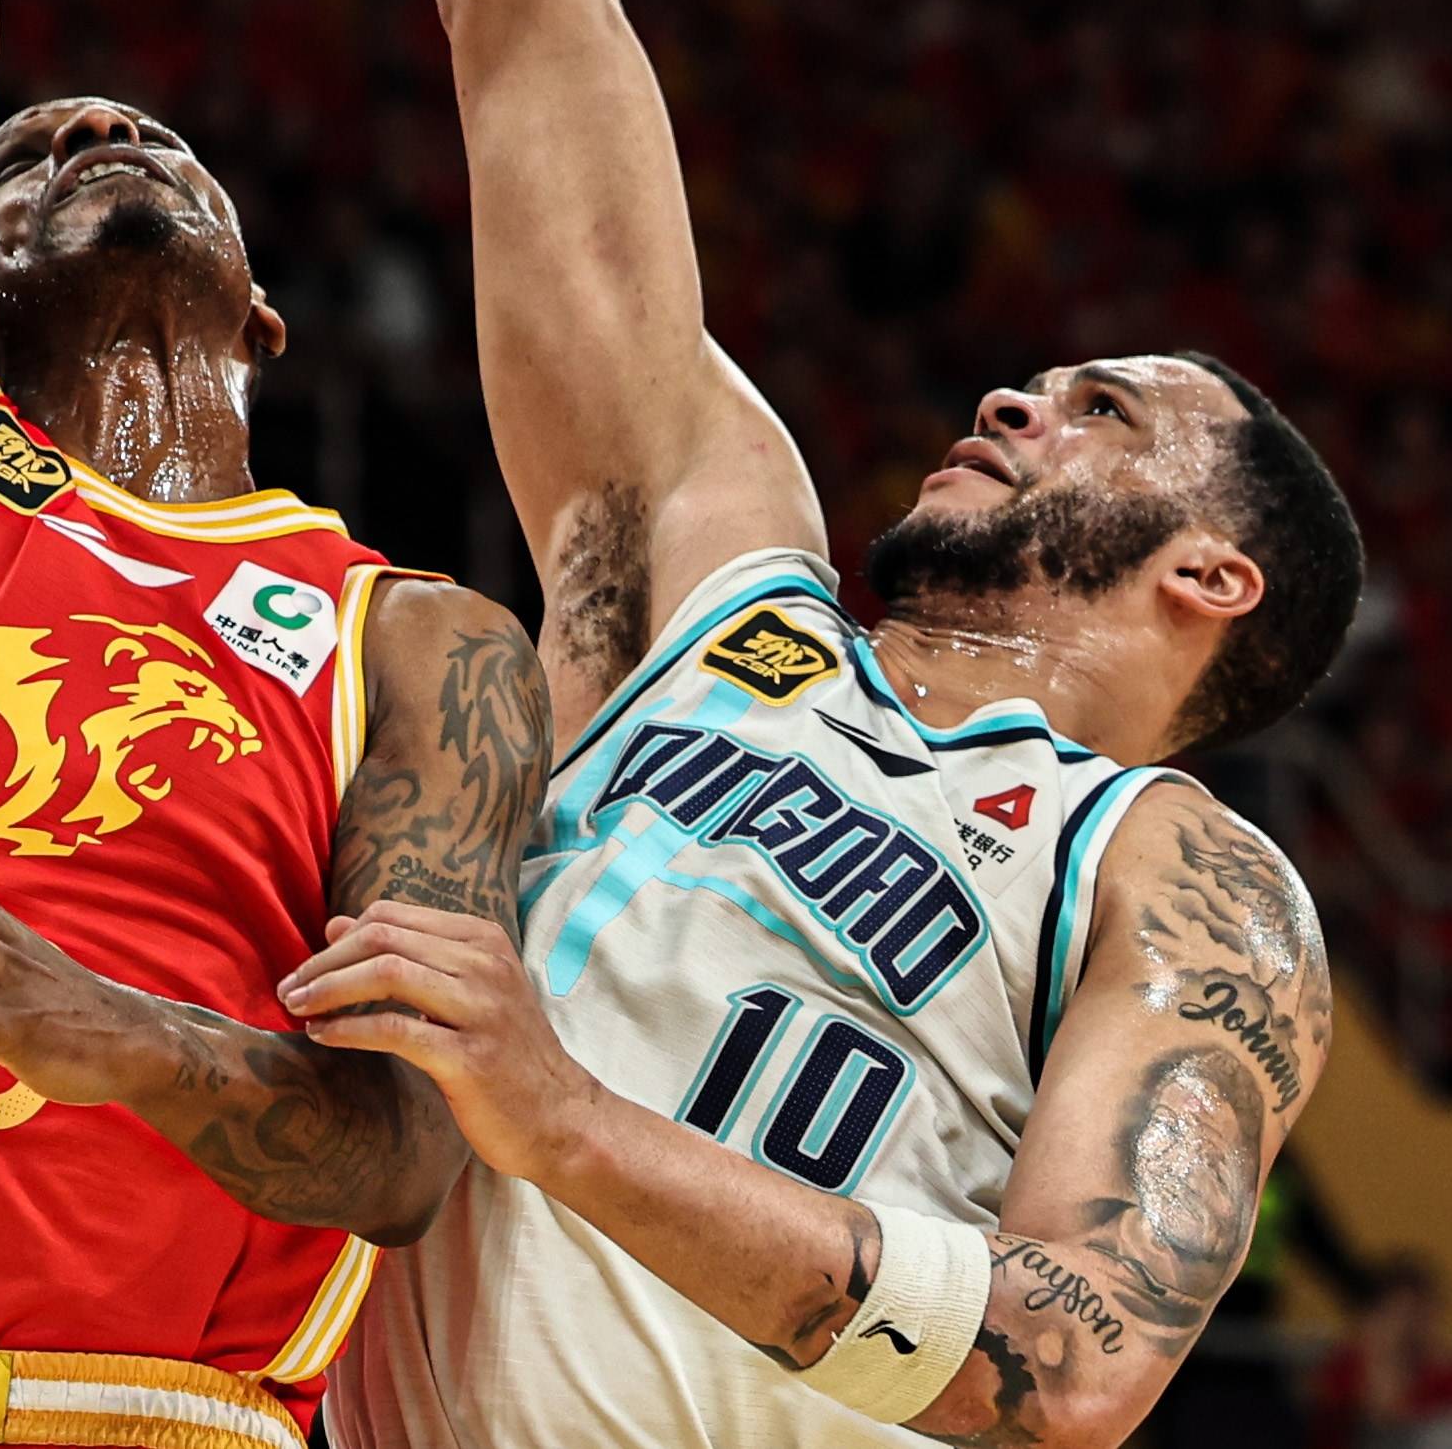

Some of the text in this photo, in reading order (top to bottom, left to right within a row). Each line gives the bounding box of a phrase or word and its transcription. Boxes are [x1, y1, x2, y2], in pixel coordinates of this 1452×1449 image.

[212, 624, 300, 681] HINA LIFE
[215, 614, 310, 669] 中国人寿
[954, 817, 1015, 864] 发银行
[673, 982, 916, 1196] 10
[992, 1233, 1124, 1354] Jayson
